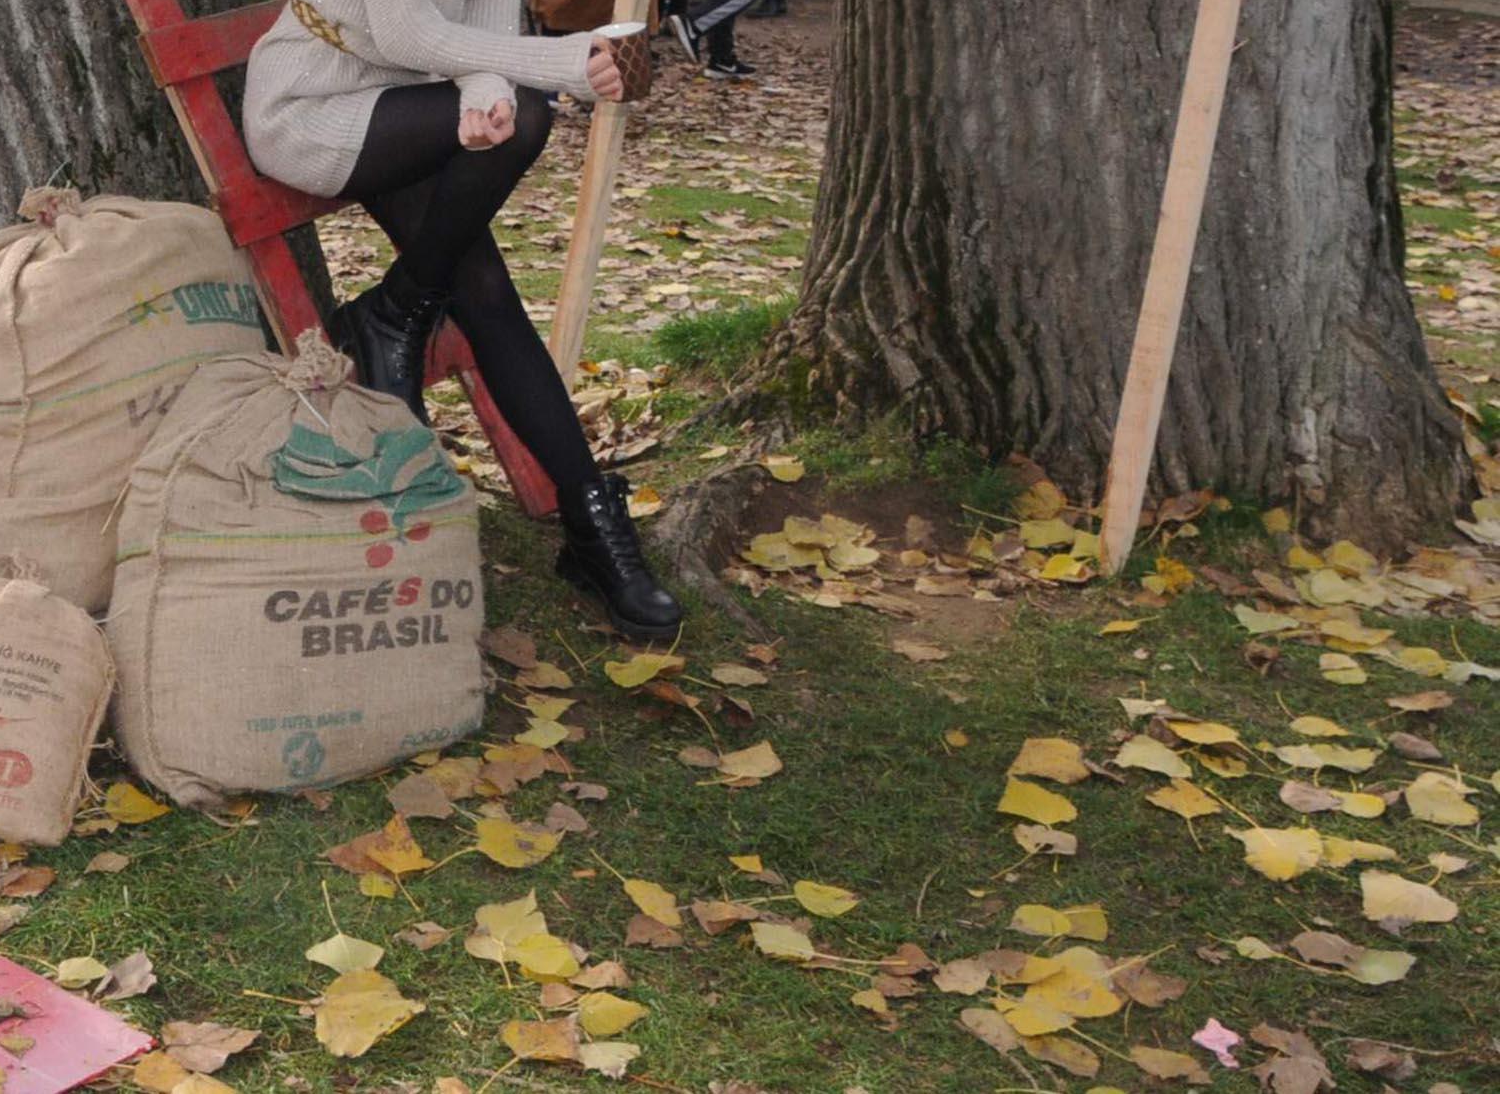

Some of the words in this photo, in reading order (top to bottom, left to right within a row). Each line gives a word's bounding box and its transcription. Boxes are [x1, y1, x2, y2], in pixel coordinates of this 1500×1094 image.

[263, 576, 423, 623] CAFÉS
[430, 579, 474, 609] DO
[301, 614, 450, 657] BRASIL
